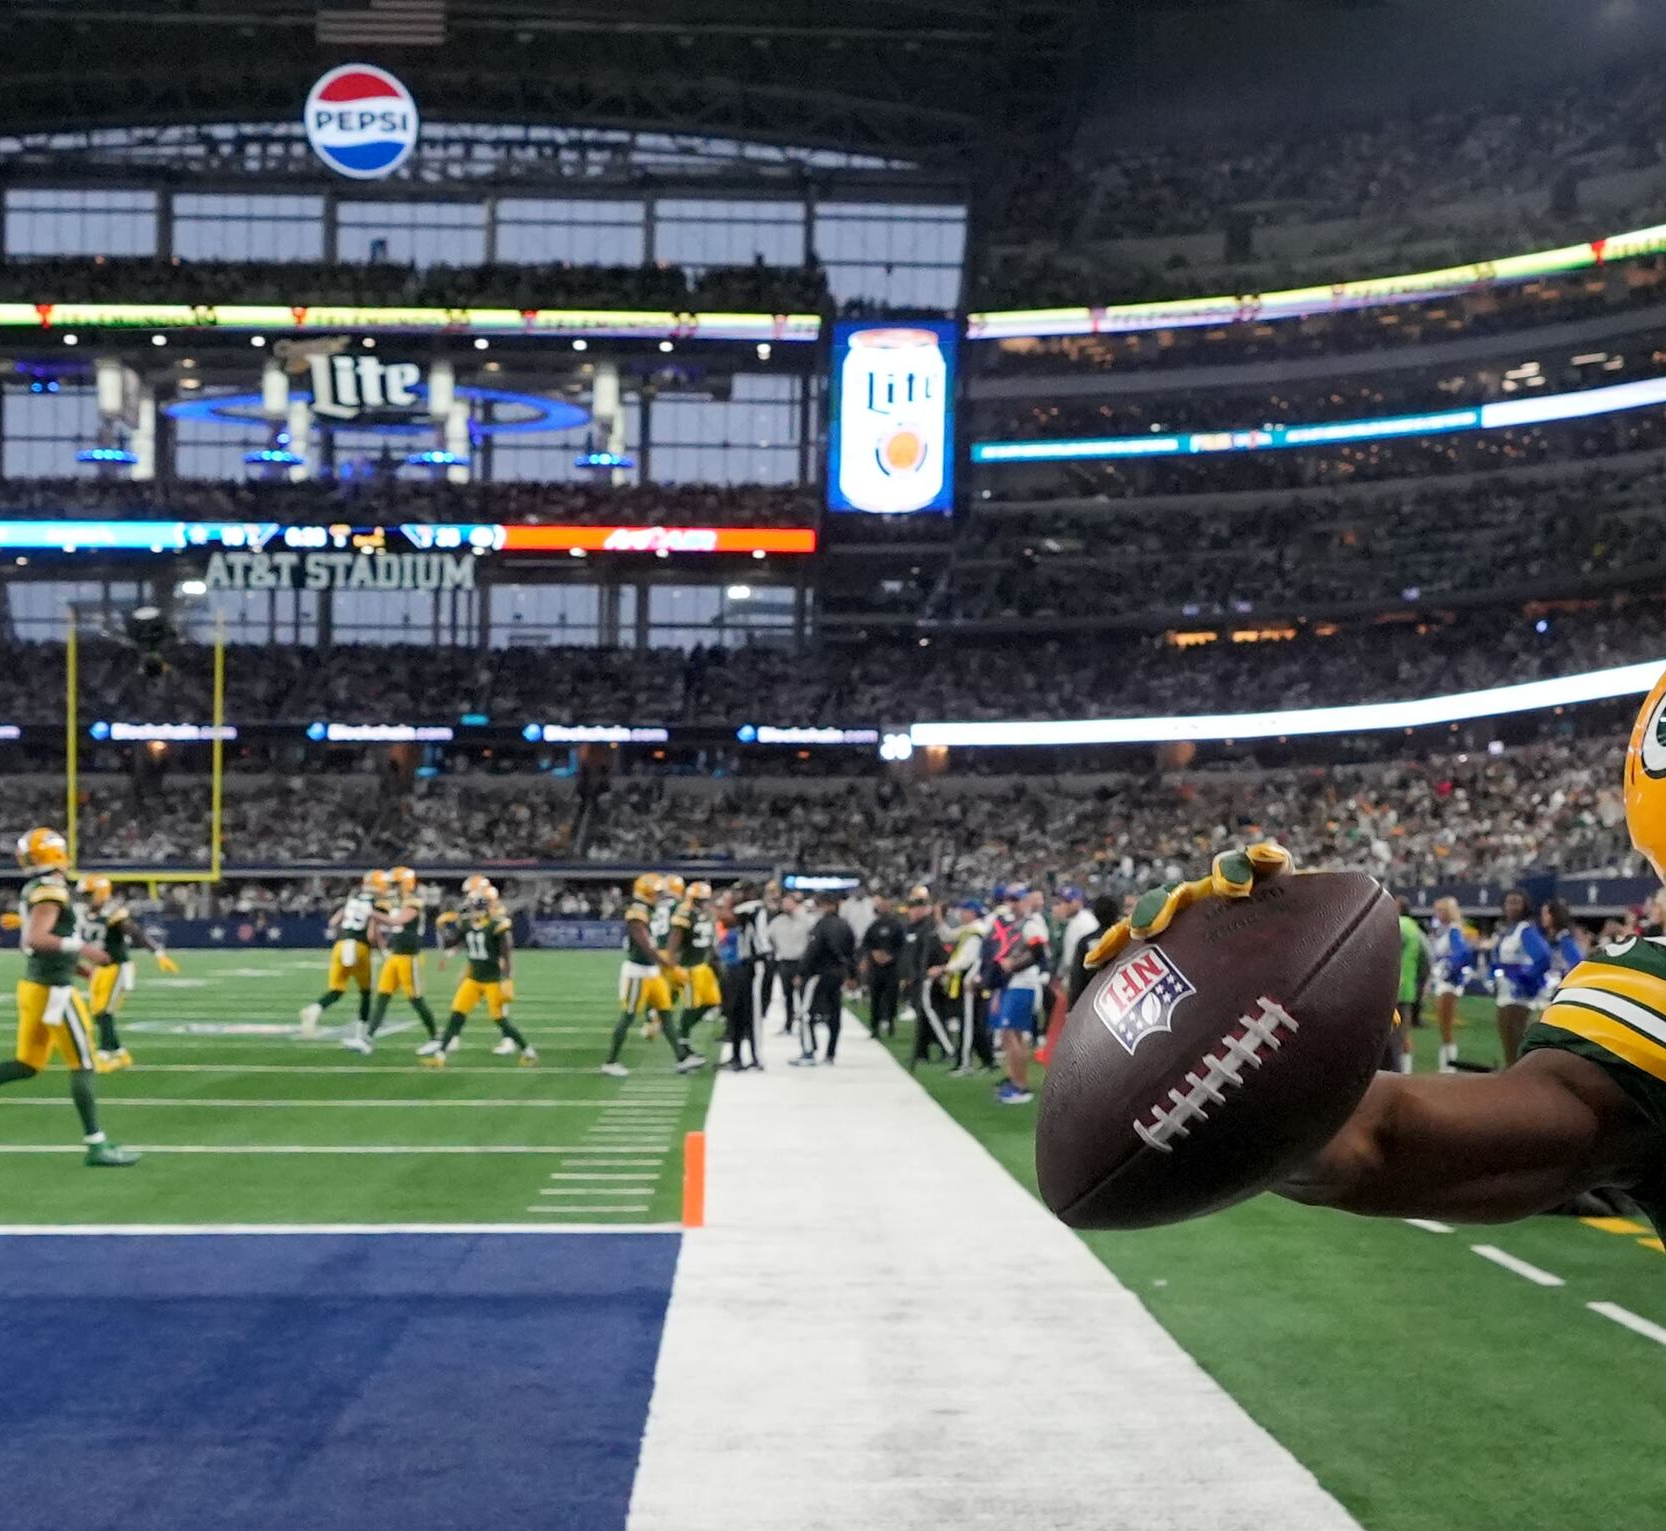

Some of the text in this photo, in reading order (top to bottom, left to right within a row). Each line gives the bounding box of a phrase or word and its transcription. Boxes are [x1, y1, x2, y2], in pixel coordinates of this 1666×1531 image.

[314, 110, 409, 132] PEPSI
[307, 354, 421, 419] Lite
[205, 551, 477, 590] AT&T STADIUM
[465, 931, 490, 962] 11
[1098, 952, 1166, 1014] NFL
